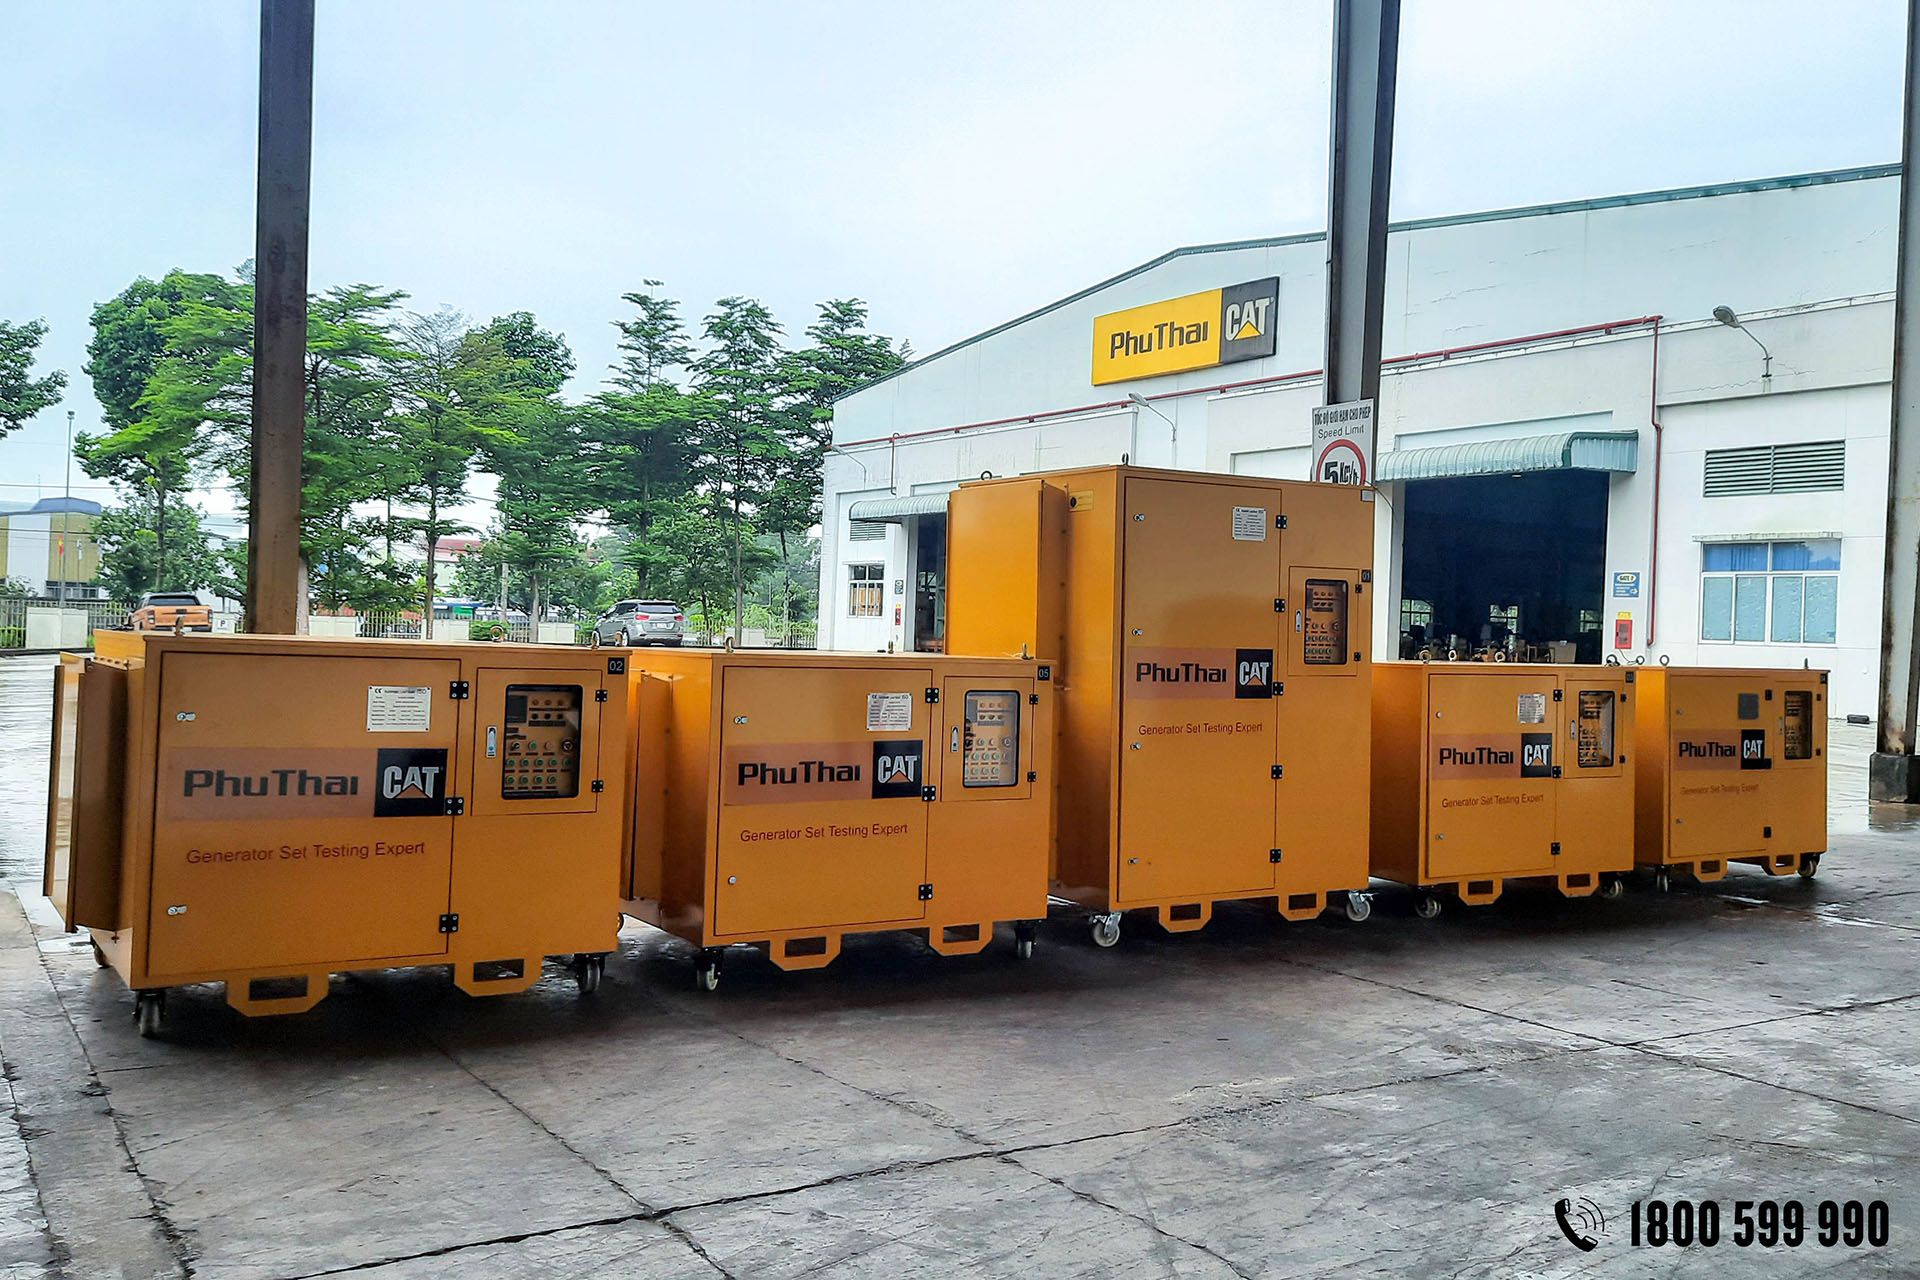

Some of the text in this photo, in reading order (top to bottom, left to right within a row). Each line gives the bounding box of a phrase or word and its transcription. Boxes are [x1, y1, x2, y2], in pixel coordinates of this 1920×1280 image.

[1110, 297, 1270, 360] PhuThai CAT
[1318, 424, 1365, 440] Speed Limit
[1324, 460, 1338, 484] 5
[609, 660, 624, 671] 02
[1038, 668, 1049, 678] 05
[1136, 661, 1270, 686] PhuThai CAT
[1138, 721, 1263, 736] Generator Set Testing Expert
[1439, 744, 1550, 767] PhuThai CAT
[1679, 739, 1763, 759] PhuThai CAT
[737, 755, 918, 786] PhuThai CAT
[183, 765, 440, 800] PhuThai CAT
[740, 823, 908, 842] Generator Set Testing Expert
[186, 841, 426, 864] Generator Set Testing Expert
